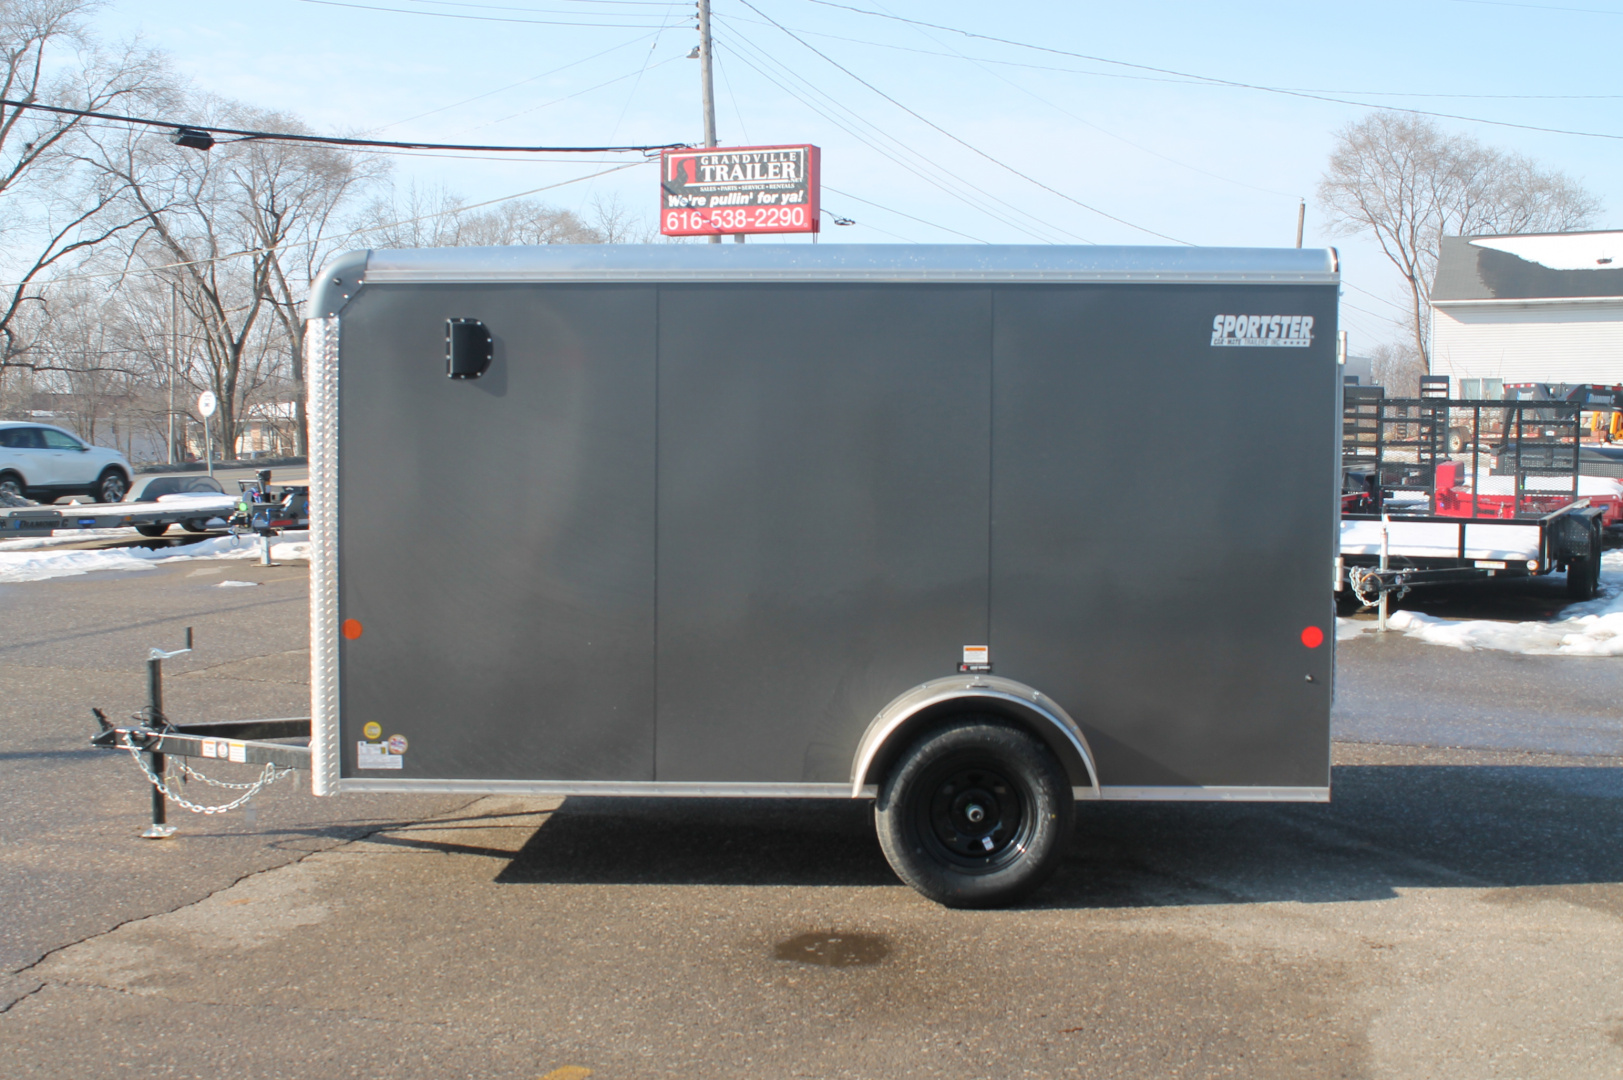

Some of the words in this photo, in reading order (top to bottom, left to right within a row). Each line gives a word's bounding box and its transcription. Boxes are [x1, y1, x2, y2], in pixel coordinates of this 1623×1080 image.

[700, 152, 797, 165] GRANDVILLE
[700, 162, 797, 182] TRAILER
[668, 194, 706, 207] We're
[709, 191, 754, 208] pullin'
[757, 190, 779, 204] for
[781, 189, 804, 205] ya!
[666, 207, 804, 230] 616-538-2290
[1212, 314, 1314, 339] SPORTSTER
